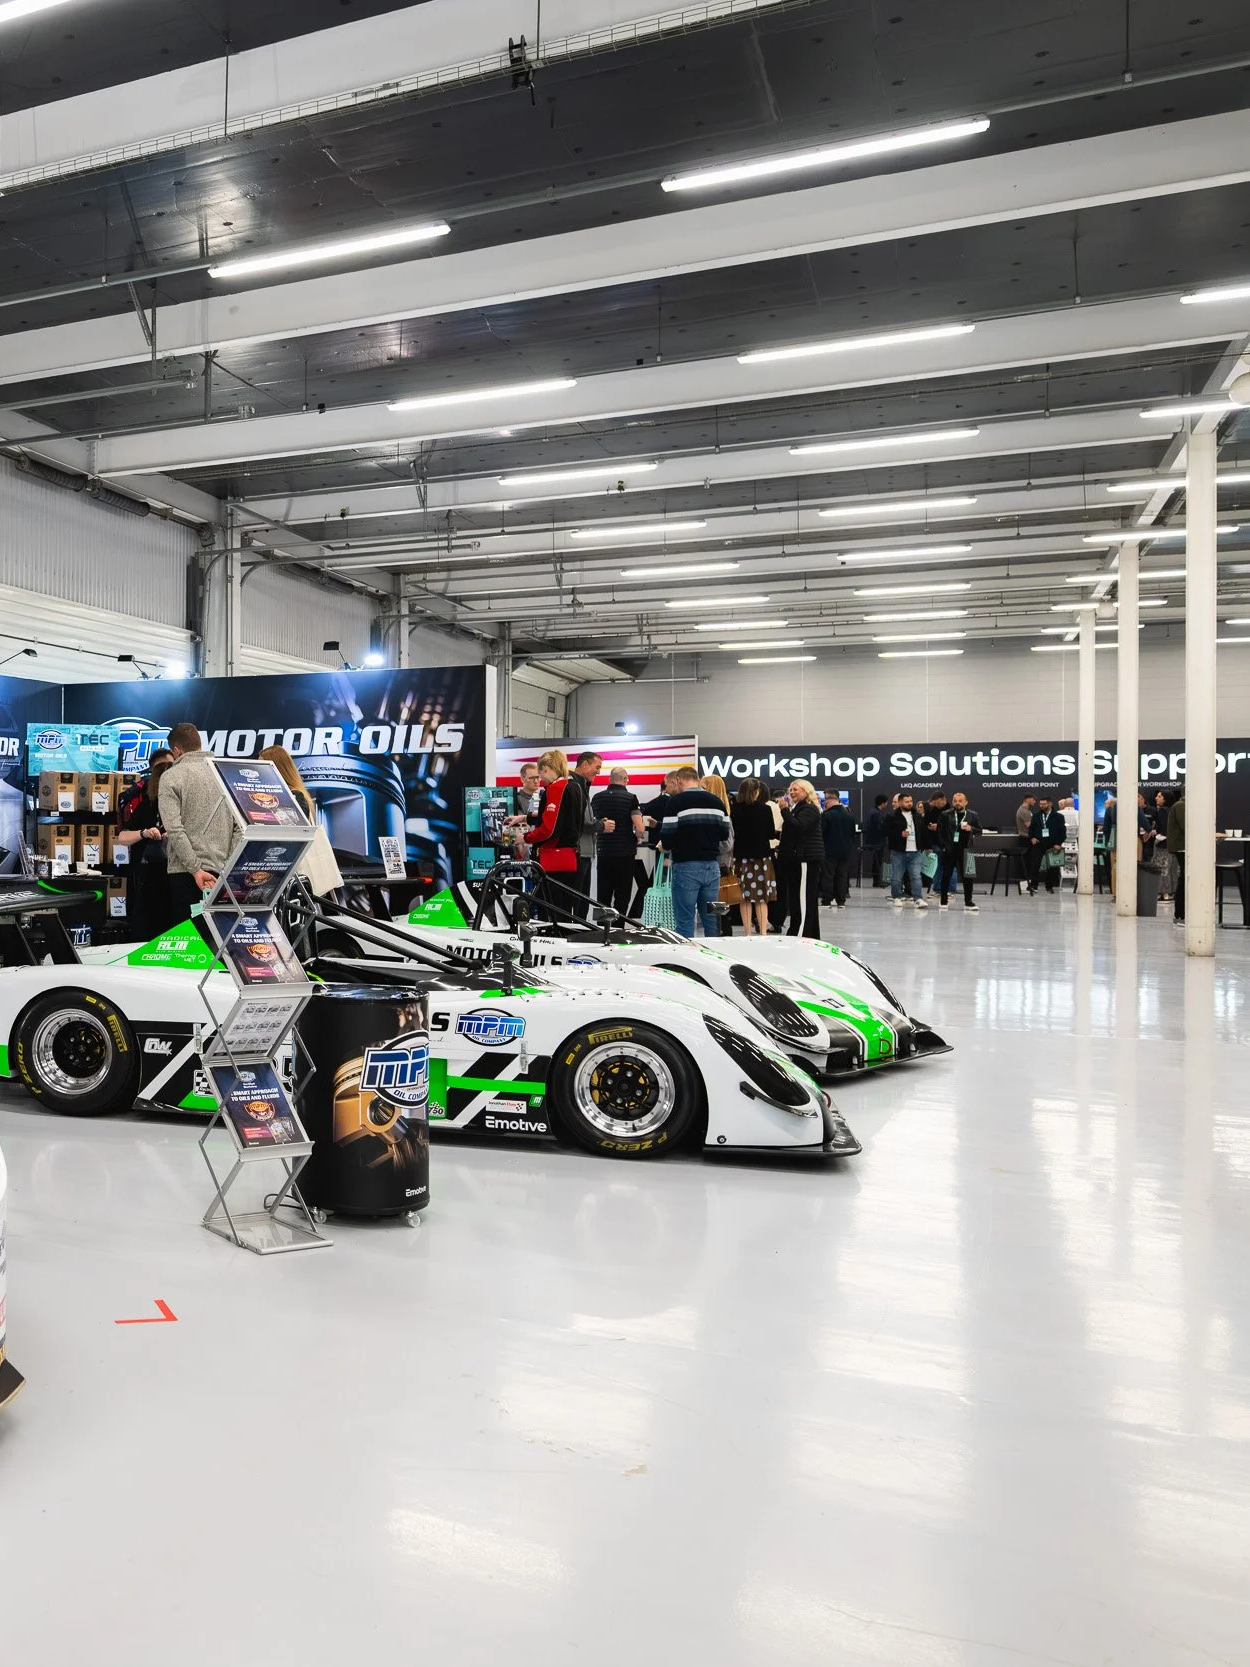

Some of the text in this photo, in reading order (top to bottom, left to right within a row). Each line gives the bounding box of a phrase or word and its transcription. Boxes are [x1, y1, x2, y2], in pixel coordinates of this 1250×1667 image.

[200, 723, 465, 758] MOTOR OILS
[700, 753, 880, 782] Workshop
[889, 748, 1076, 777] Solutions
[107, 1014, 128, 1053] PIRELLI
[588, 1026, 633, 1045] PIRELLI
[250, 1087, 279, 1095] APPROACH
[393, 1089, 406, 1099] OIL
[485, 1116, 547, 1132] Emotive
